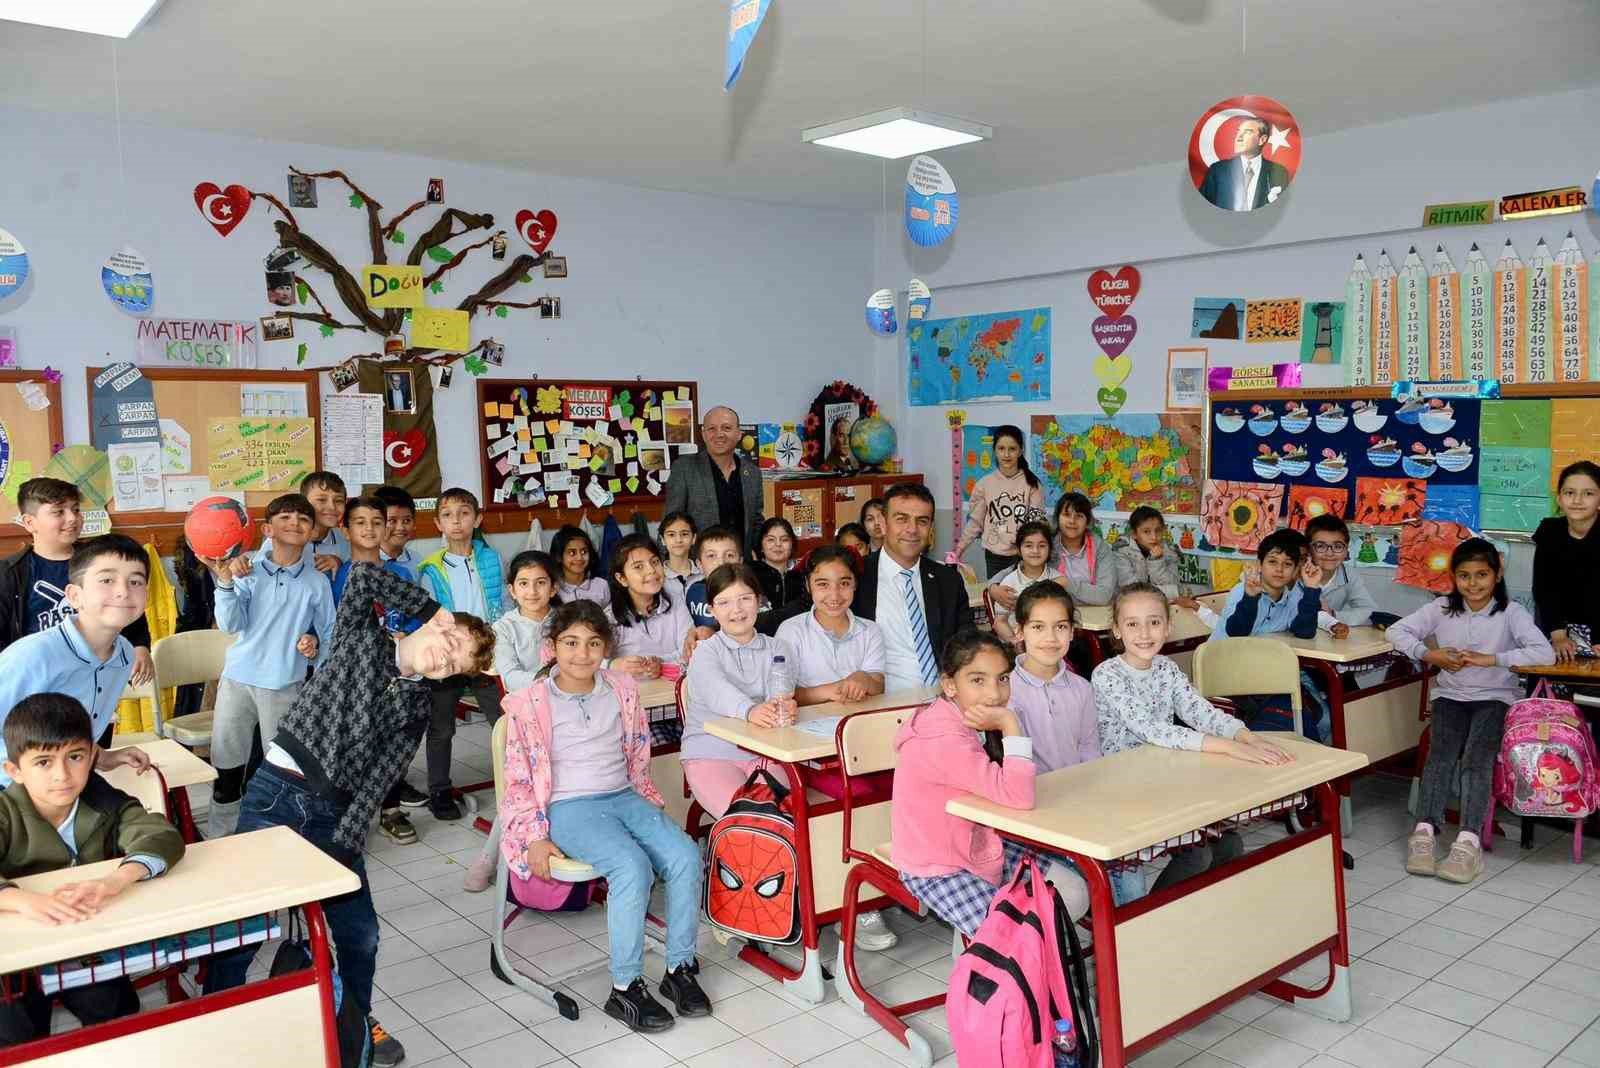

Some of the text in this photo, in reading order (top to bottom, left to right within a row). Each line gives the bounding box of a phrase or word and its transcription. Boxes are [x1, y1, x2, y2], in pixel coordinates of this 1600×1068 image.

[1429, 191, 1588, 225] RİTMİK KALEMLER
[1536, 268, 1544, 278] 7
[1566, 267, 1572, 276] 8
[1473, 276, 1478, 284] 5
[1506, 272, 1512, 280] 6
[1409, 280, 1415, 288] 3
[1503, 283, 1514, 291] 12
[1532, 279, 1546, 288] 14
[1563, 279, 1576, 288] 16
[1410, 291, 1415, 299] 6
[1471, 287, 1482, 295] 10
[1532, 290, 1546, 299] 21
[1504, 294, 1515, 302] 18
[1563, 291, 1576, 300] 24
[1410, 302, 1415, 310] 9
[1472, 299, 1482, 307] 15
[1532, 302, 1546, 311] 28
[1563, 302, 1576, 311] 32
[1472, 308, 1483, 316] 20
[1503, 306, 1515, 314] 24
[1408, 312, 1418, 320] 12
[1531, 313, 1546, 322] 35
[1565, 313, 1577, 322] 40
[1472, 320, 1483, 328] 25
[1503, 317, 1515, 325] 30
[1503, 328, 1514, 336] 36
[1530, 323, 1545, 333] 42
[1564, 324, 1577, 333] 48
[1440, 331, 1451, 339] 24
[1472, 330, 1483, 338] 30
[1408, 335, 1418, 343] 18
[1530, 336, 1545, 345] 49
[1565, 336, 1577, 345] 56
[1440, 341, 1451, 349] 28
[1472, 340, 1483, 348] 35
[1503, 339, 1514, 348] 42
[1440, 352, 1451, 360] 32
[1471, 352, 1483, 360] 40
[1503, 350, 1513, 359] 48
[1530, 348, 1545, 358] 56
[1565, 348, 1578, 357] 64
[1408, 357, 1418, 365] 24
[1531, 360, 1545, 369] 63
[1566, 359, 1578, 368] 72
[1440, 362, 1451, 370] 36
[1471, 363, 1483, 371] 45
[1503, 362, 1513, 370] 54
[1502, 375, 1514, 383] 60
[1531, 370, 1545, 381] 70
[1566, 371, 1579, 379] 80
[568, 390, 607, 401] MERAK
[570, 403, 605, 418] KÖŞESİ
